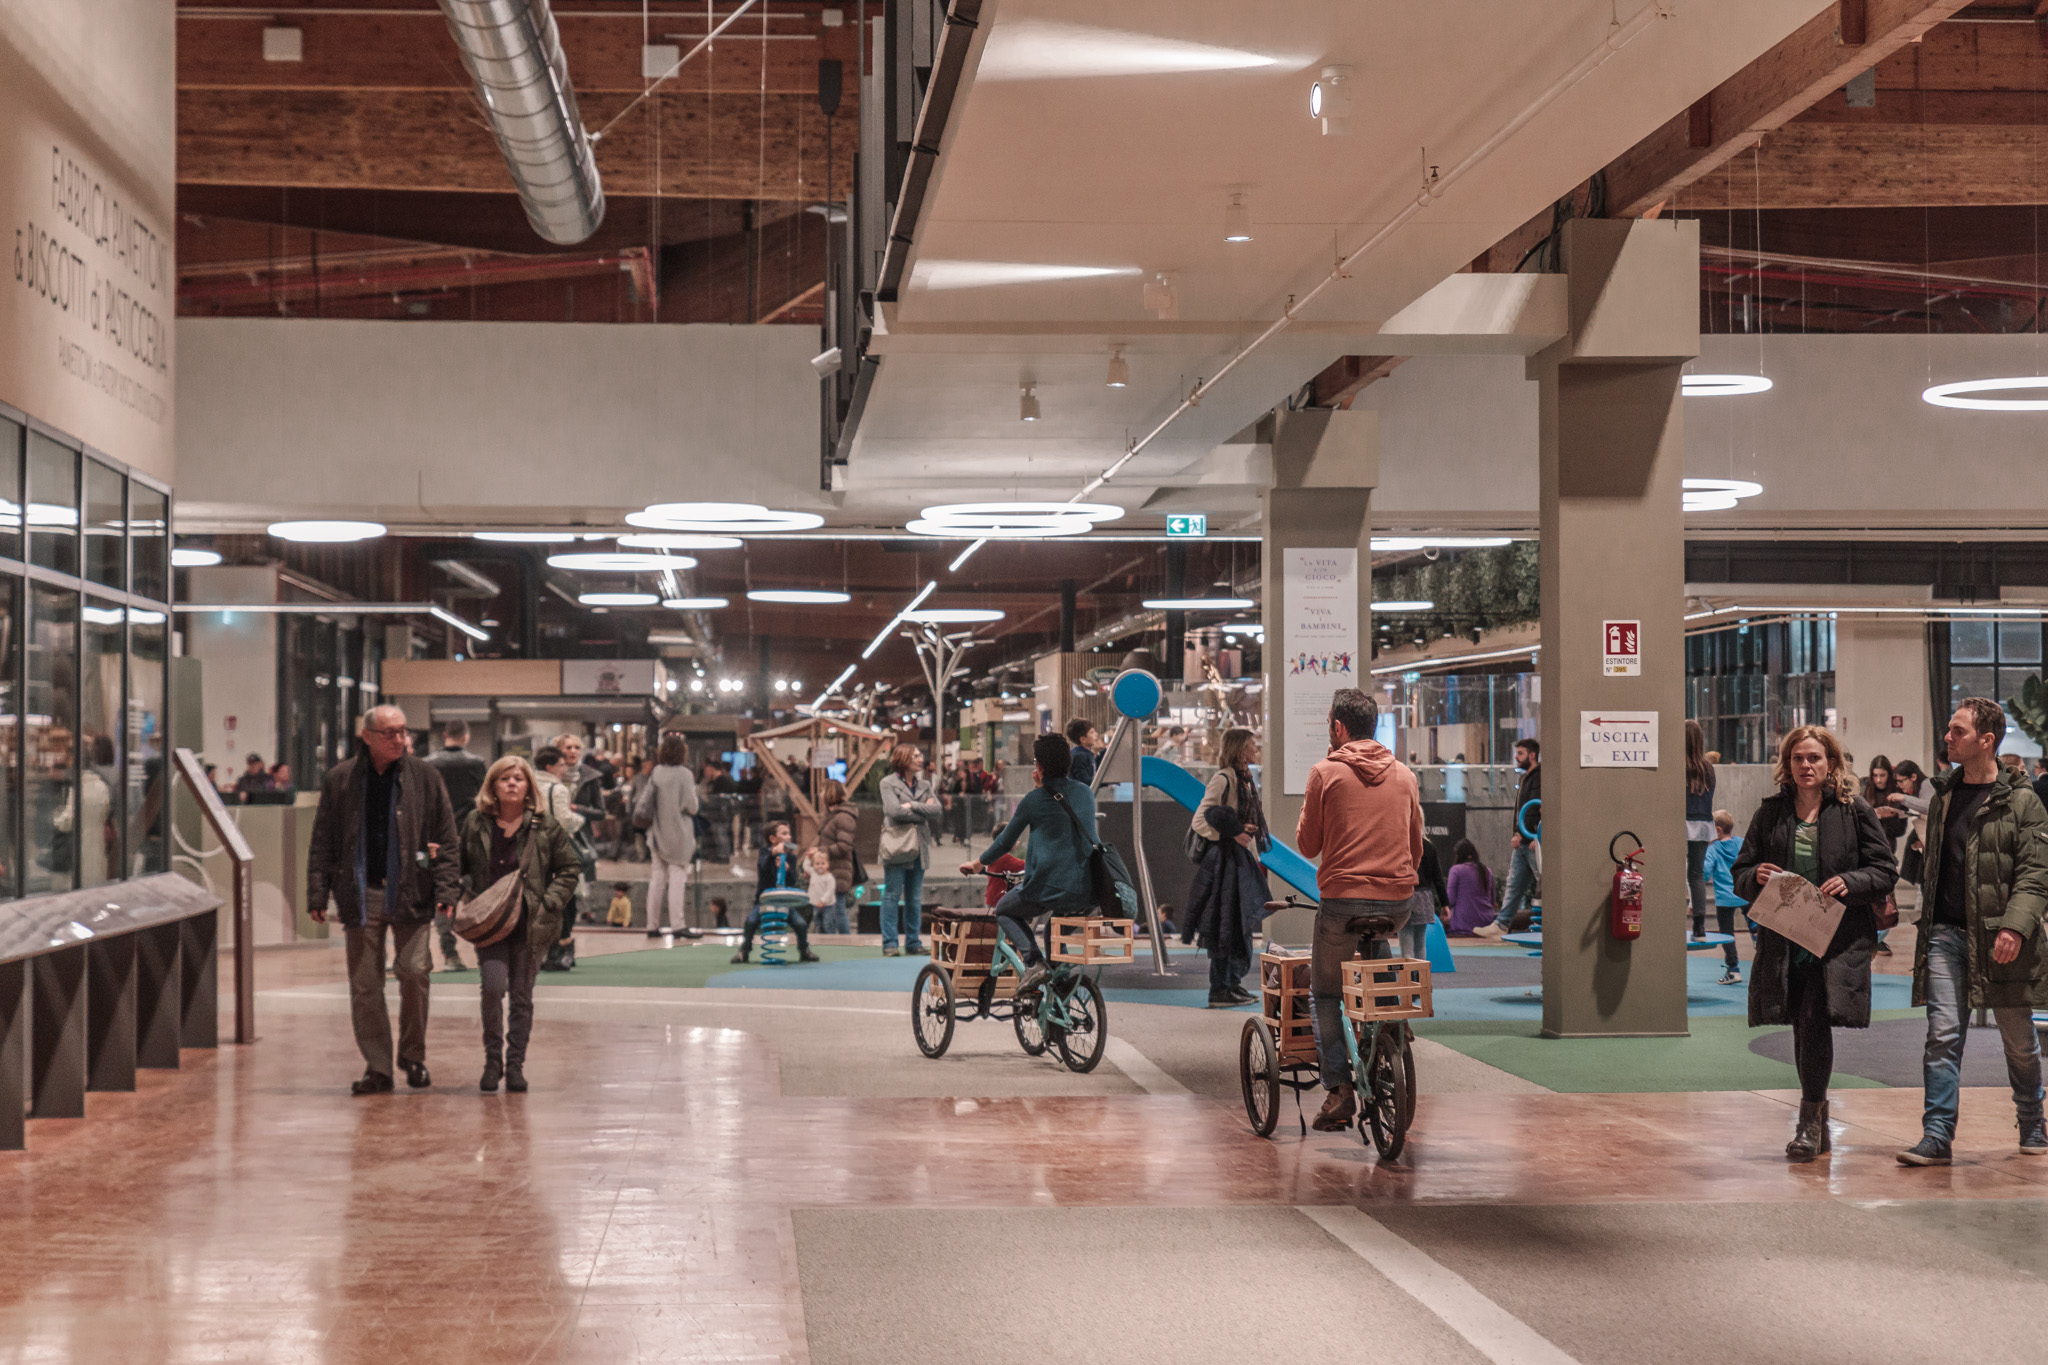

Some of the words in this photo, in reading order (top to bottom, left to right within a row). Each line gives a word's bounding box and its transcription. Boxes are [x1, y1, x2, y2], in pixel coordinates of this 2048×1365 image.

[52, 145, 109, 253] FABBRICA
[14, 228, 23, 281] &
[28, 221, 87, 322] BISCOTTI
[104, 279, 167, 376] PASTICCERIA
[1591, 731, 1650, 743] USCITA
[1611, 750, 1650, 762] EXIT
